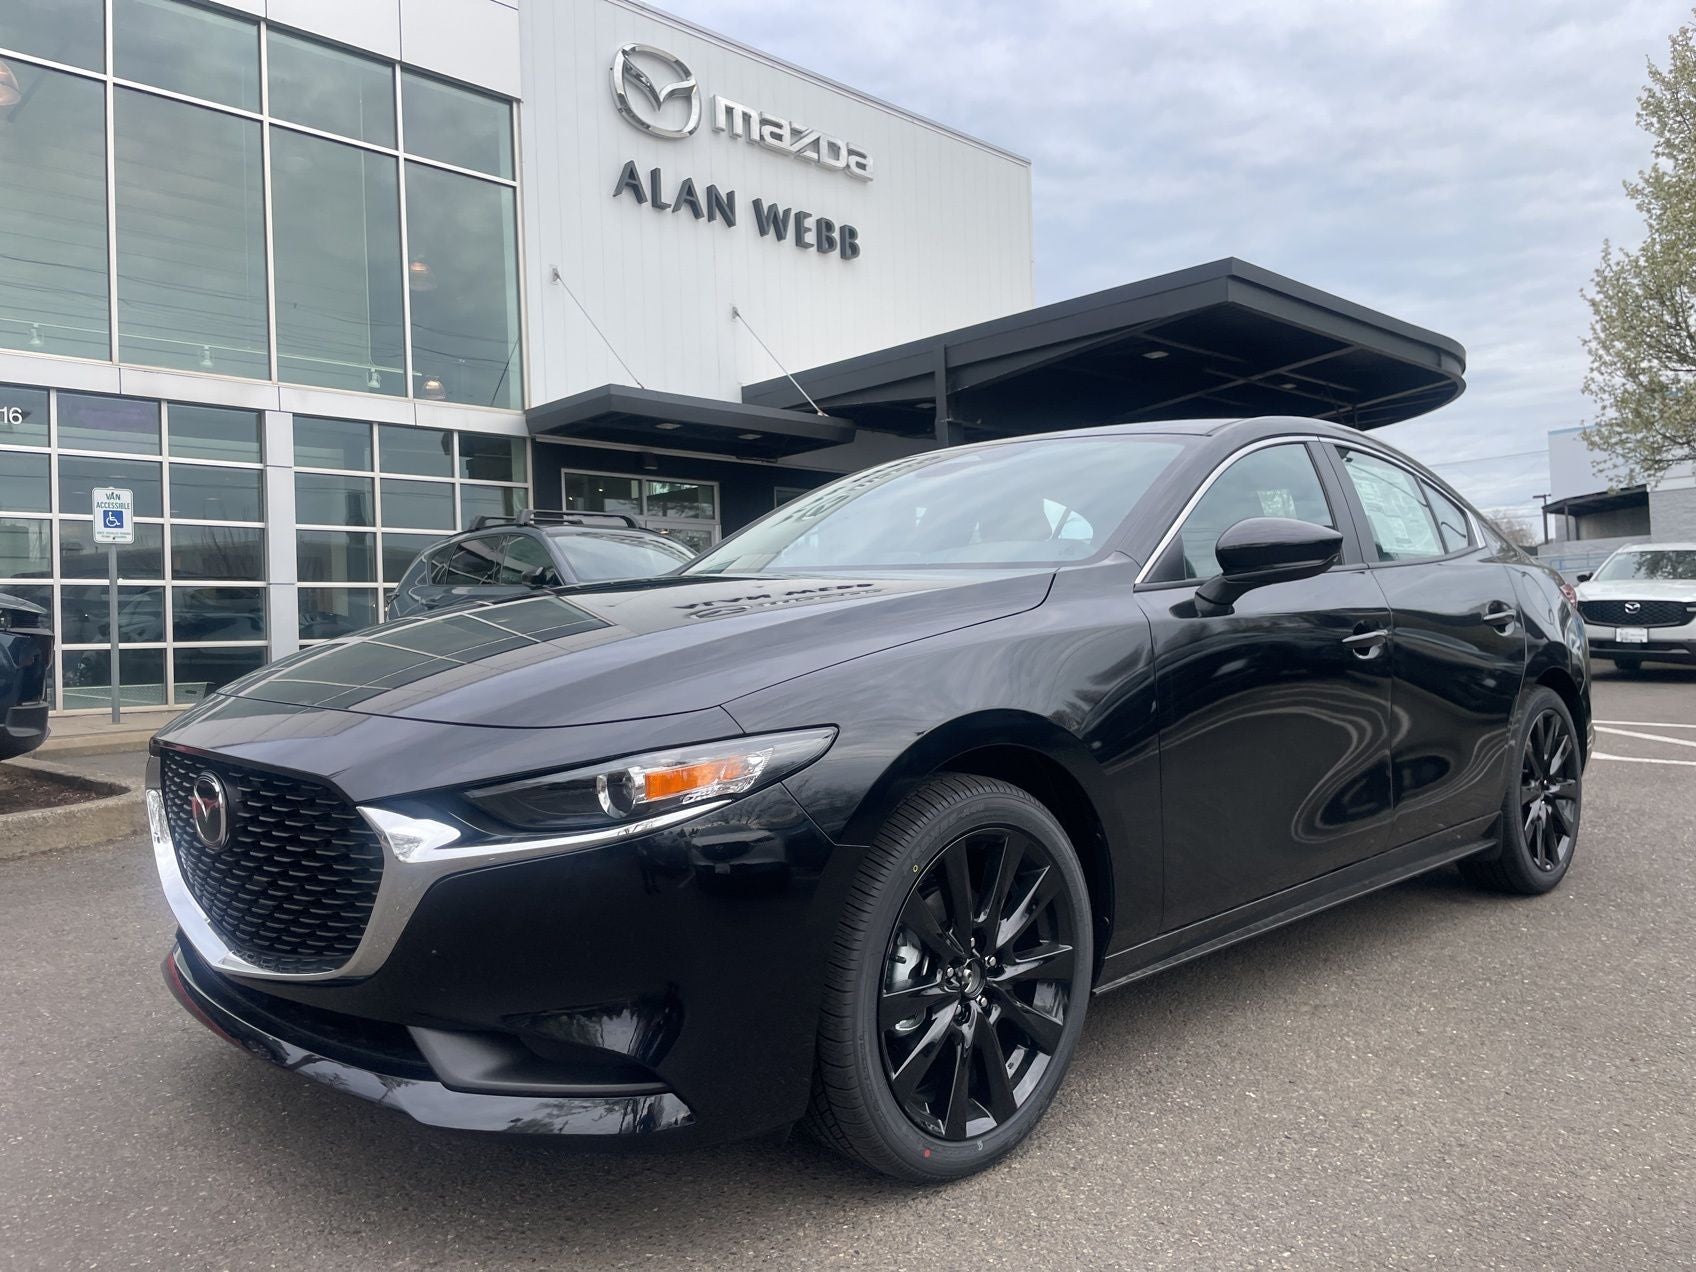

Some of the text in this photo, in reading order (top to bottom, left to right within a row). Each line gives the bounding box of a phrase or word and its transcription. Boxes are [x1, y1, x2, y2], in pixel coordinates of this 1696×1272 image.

[612, 160, 861, 260] ALAN WEBB
[0, 406, 22, 424] 16
[105, 492, 121, 500] VAN
[96, 501, 131, 509] ACCESSIBLE
